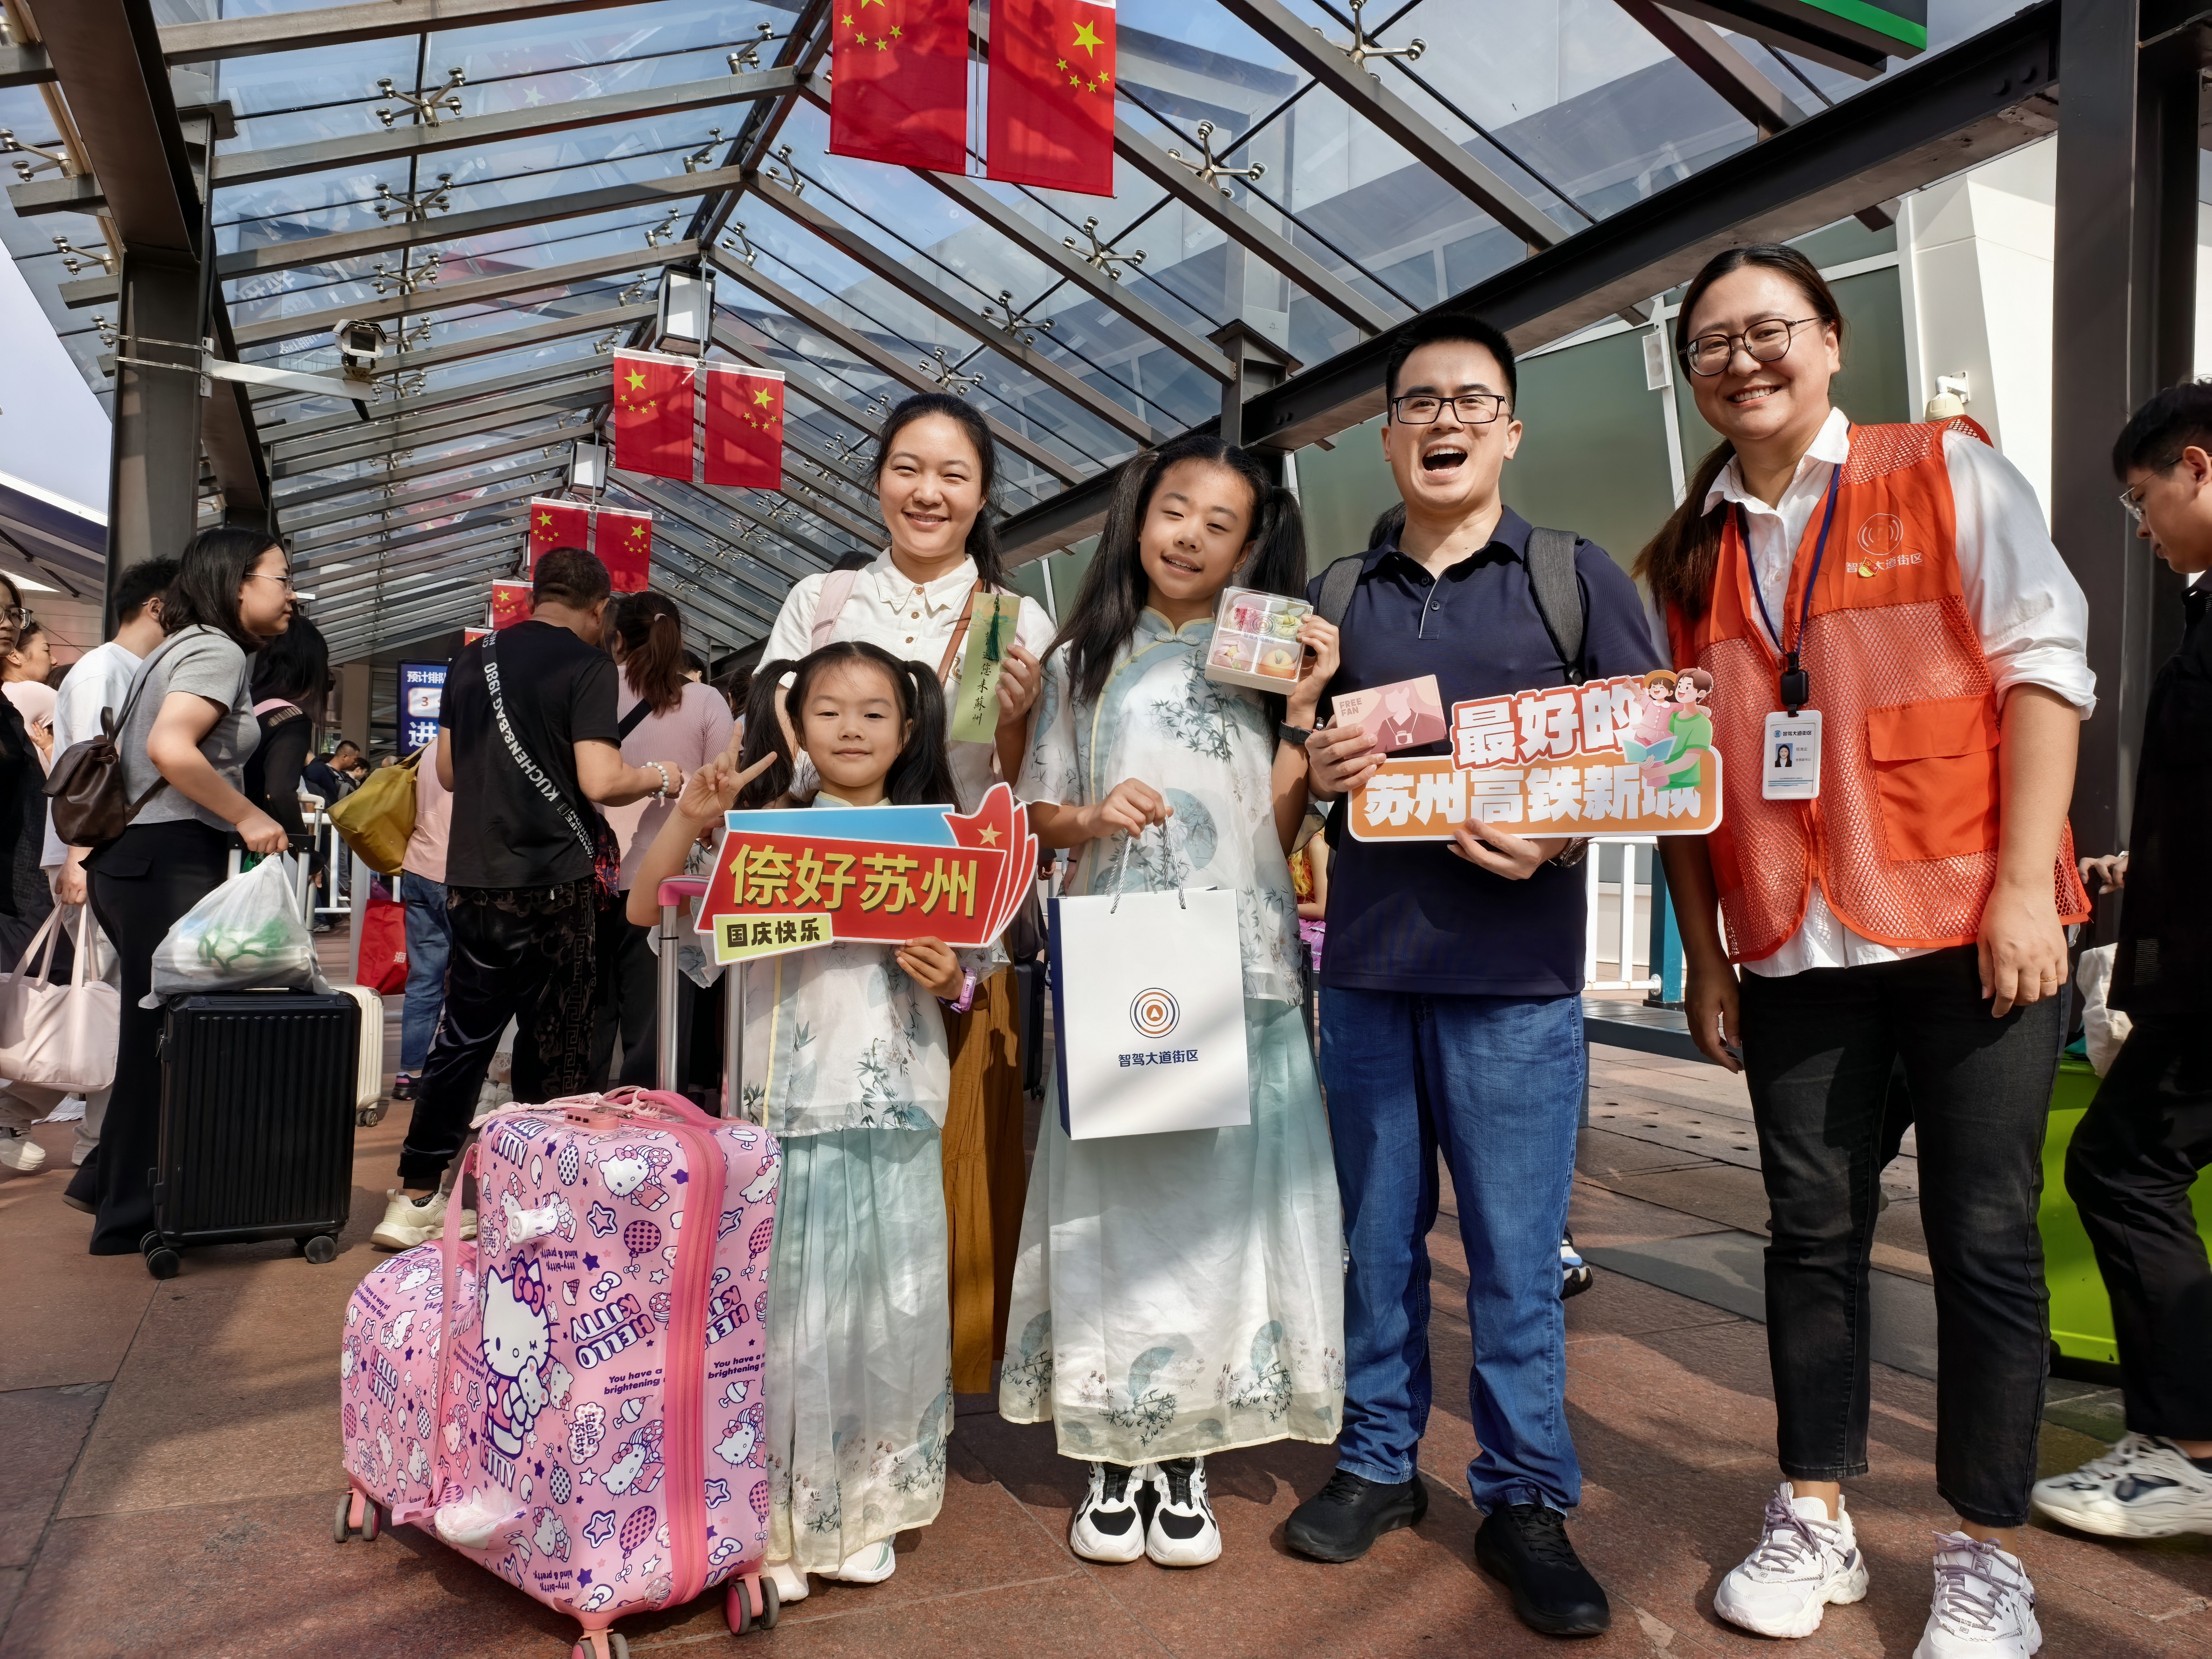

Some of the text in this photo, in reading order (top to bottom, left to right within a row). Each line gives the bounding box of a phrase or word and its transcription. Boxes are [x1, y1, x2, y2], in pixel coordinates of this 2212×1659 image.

[1845, 552, 1923, 573] 智大道街区
[421, 696, 429, 707] 3
[1339, 697, 1363, 709] FREE
[1341, 706, 1359, 717] FAN
[1458, 682, 1645, 764] 最好的
[729, 844, 977, 917] 倷好苏州
[727, 918, 820, 948] 国庆快乐
[1118, 1049, 1199, 1067] 智驾大道街区
[491, 1127, 528, 1170] KITTY
[564, 1250, 578, 1259] kind
[570, 1293, 642, 1344] KITTY
[575, 1314, 656, 1370] HELLO
[370, 1345, 399, 1393] HELLO
[708, 1364, 759, 1379] brightening
[714, 1360, 731, 1369] You
[733, 1355, 754, 1365] have
[604, 1377, 660, 1395] brightening
[609, 1375, 626, 1384] You
[628, 1370, 652, 1380] have
[368, 1367, 395, 1414] KITTY
[574, 1422, 585, 1456] Kitty
[584, 1412, 596, 1446] Hello
[480, 1440, 516, 1493] KITTY
[554, 1572, 558, 1580] &
[559, 1569, 572, 1580] kind
